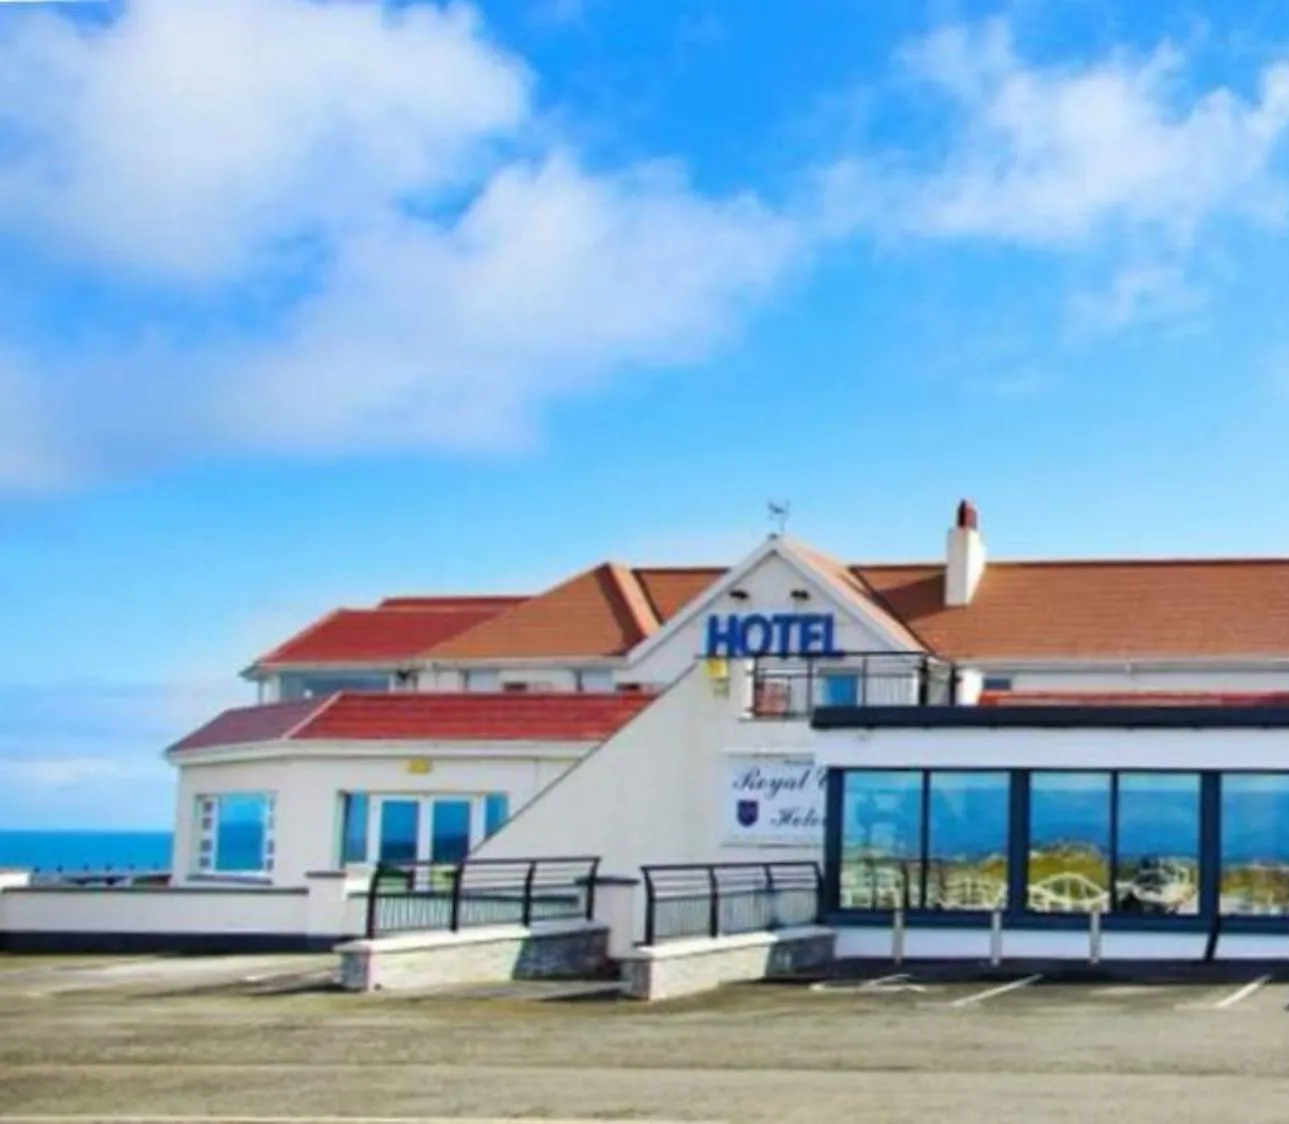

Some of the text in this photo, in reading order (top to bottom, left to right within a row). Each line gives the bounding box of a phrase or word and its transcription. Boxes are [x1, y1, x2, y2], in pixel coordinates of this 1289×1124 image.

[707, 612, 846, 658] HOTEL
[731, 765, 811, 801] Royal
[769, 805, 826, 828] Hote
